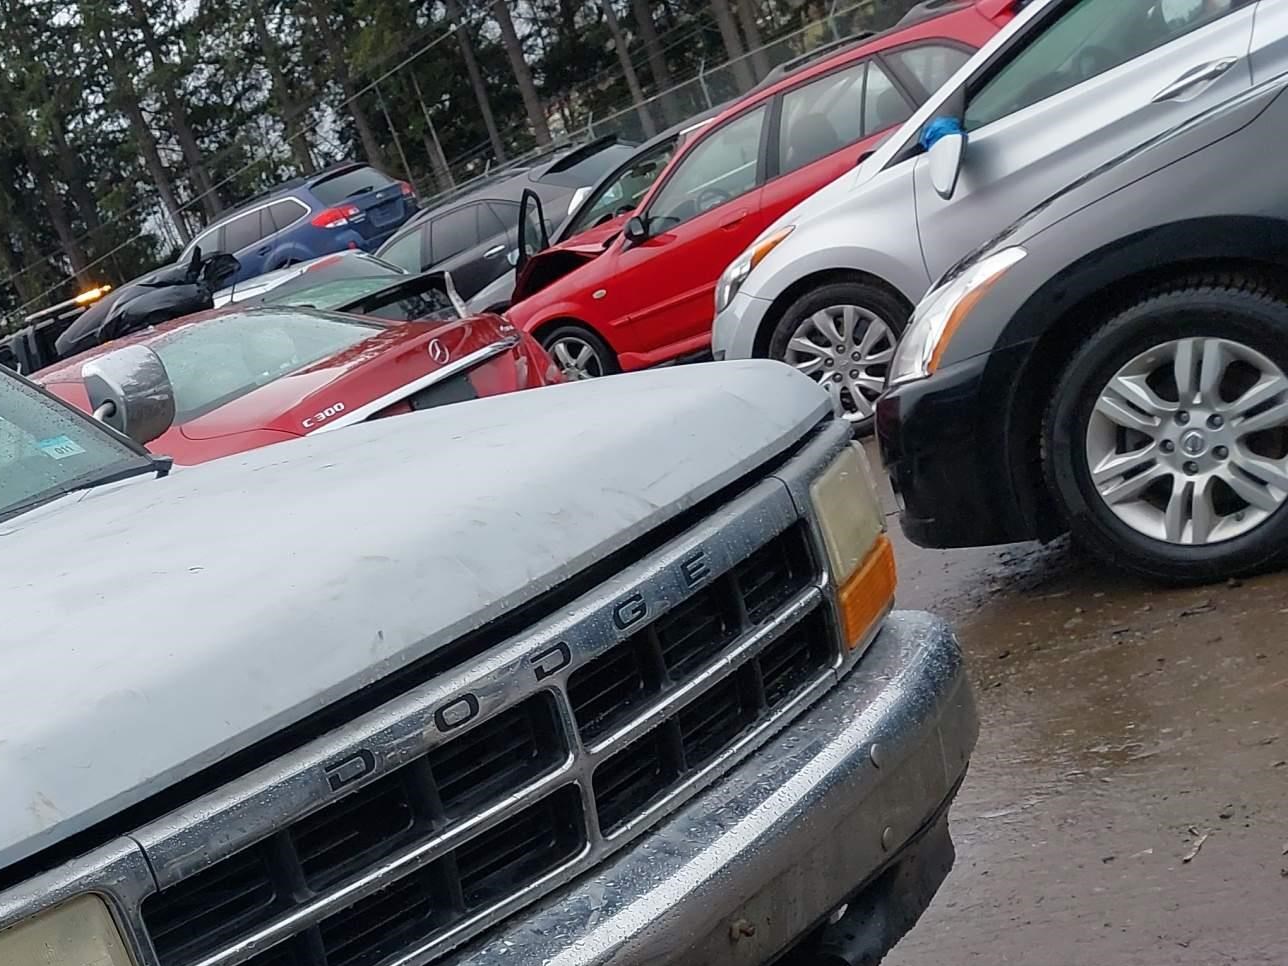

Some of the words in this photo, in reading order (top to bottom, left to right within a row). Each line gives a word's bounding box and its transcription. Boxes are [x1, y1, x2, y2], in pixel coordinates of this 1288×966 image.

[302, 418, 315, 429] C
[314, 402, 345, 422] 300
[323, 551, 711, 792] DODGE
